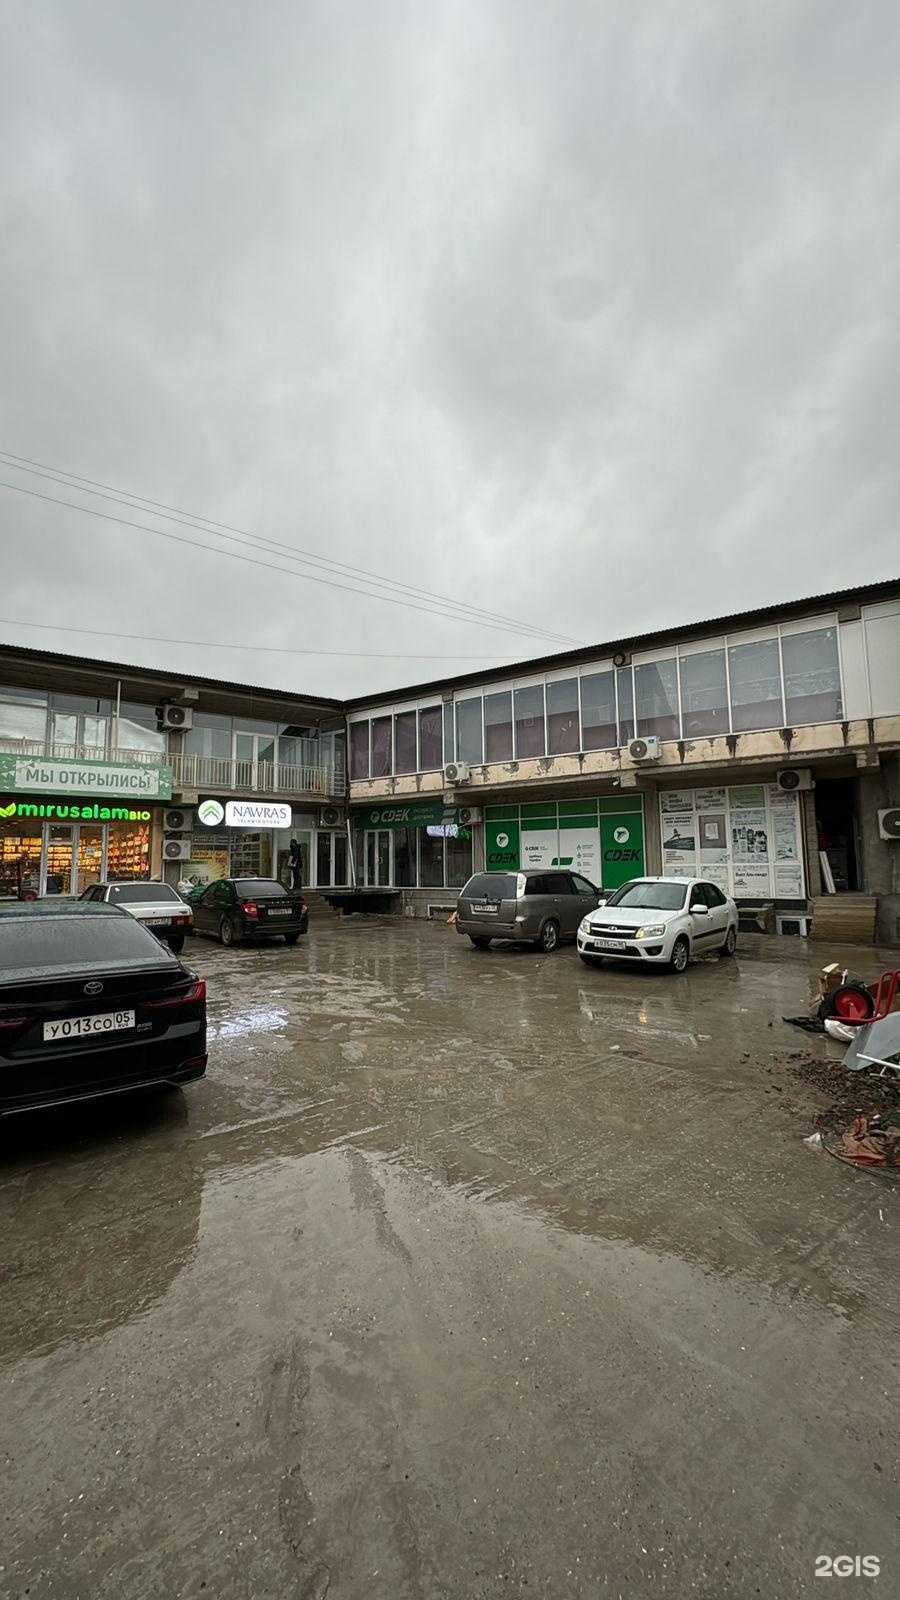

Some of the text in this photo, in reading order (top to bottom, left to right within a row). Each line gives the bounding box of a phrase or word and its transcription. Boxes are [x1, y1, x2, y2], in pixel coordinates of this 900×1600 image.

[26, 769, 151, 789] МЫ ОТКРЫЛИСЬ!
[17, 803, 151, 820] mirusalam BIO
[233, 806, 287, 819] NAWRAS
[381, 808, 410, 822] CDEK
[488, 851, 516, 864] CDEK
[604, 849, 640, 862] CDEK
[116, 1012, 130, 1024] 05
